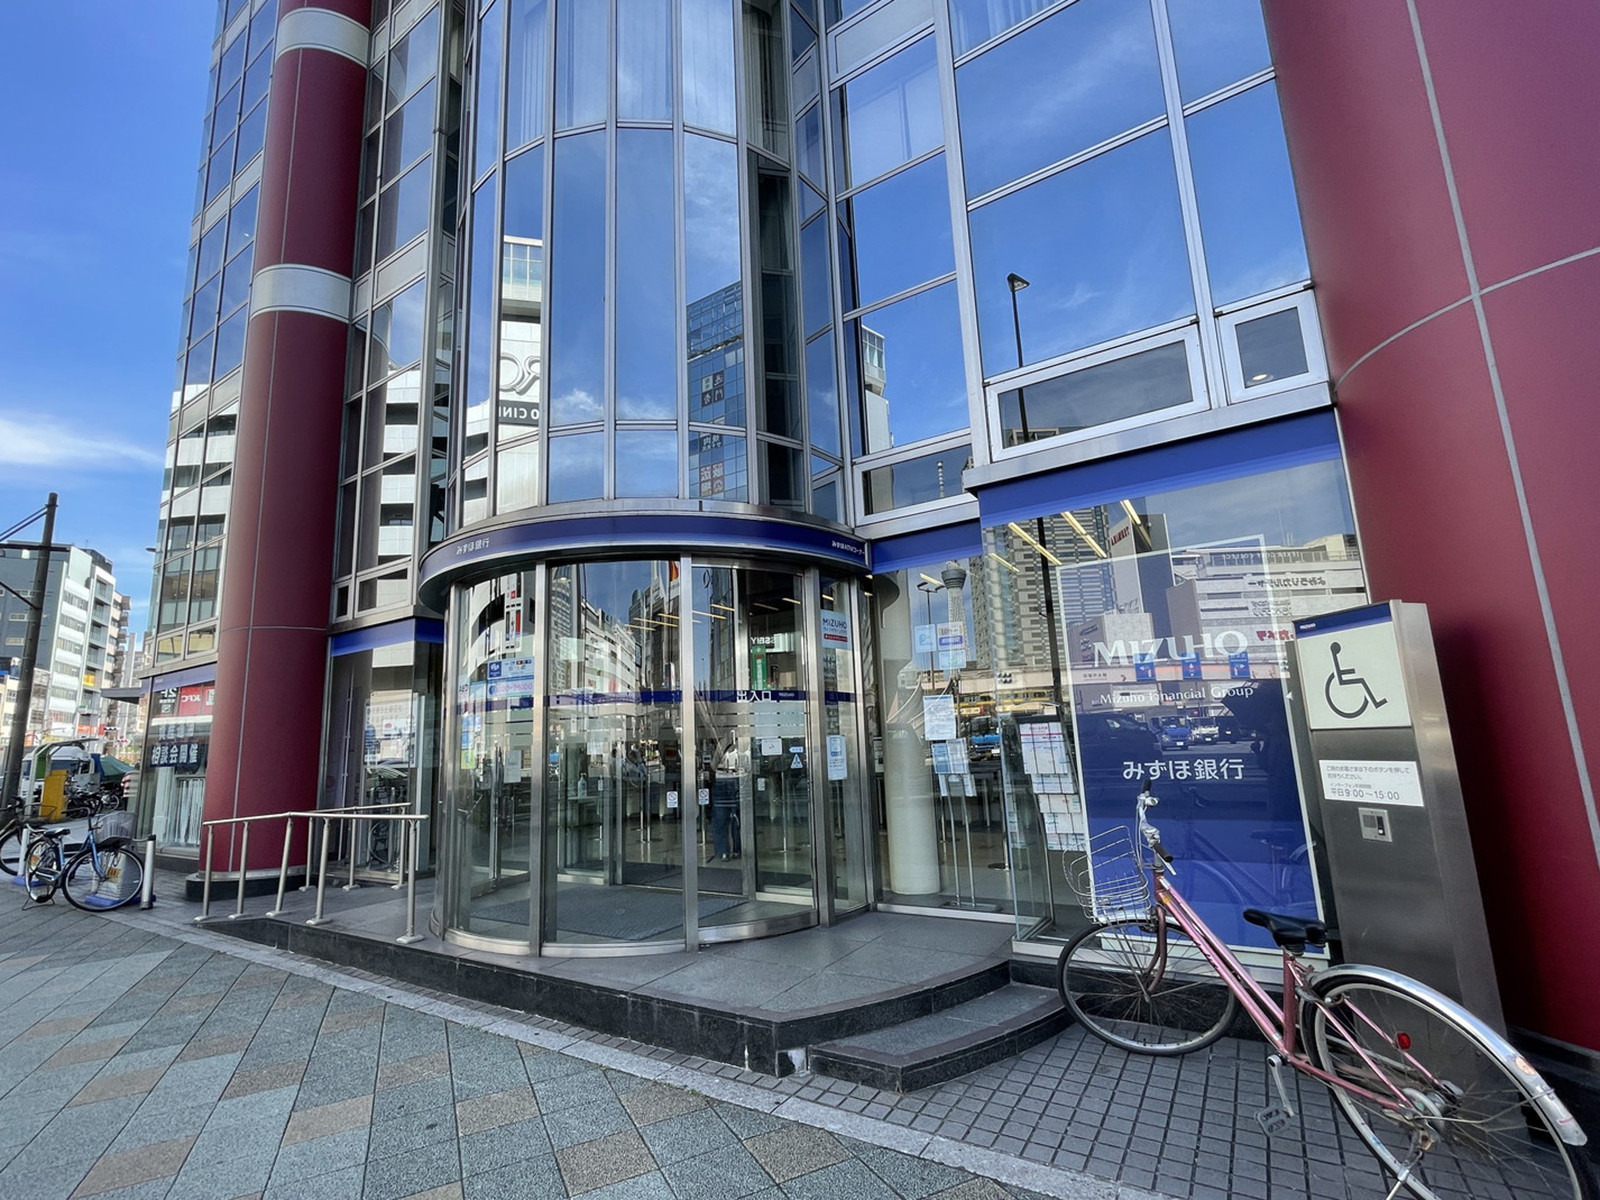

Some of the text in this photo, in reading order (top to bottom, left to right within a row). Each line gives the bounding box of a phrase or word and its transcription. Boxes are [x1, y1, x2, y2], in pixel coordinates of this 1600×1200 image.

[456, 538, 490, 555] みずほ銀行
[823, 618, 848, 629] MIZUHO
[1093, 630, 1249, 667] MIZUHO
[736, 690, 771, 702] 出入口
[1100, 685, 1254, 704] Mizuho Financial Group
[151, 743, 198, 765] 相談会開催
[1122, 758, 1245, 780] みずほ銀行
